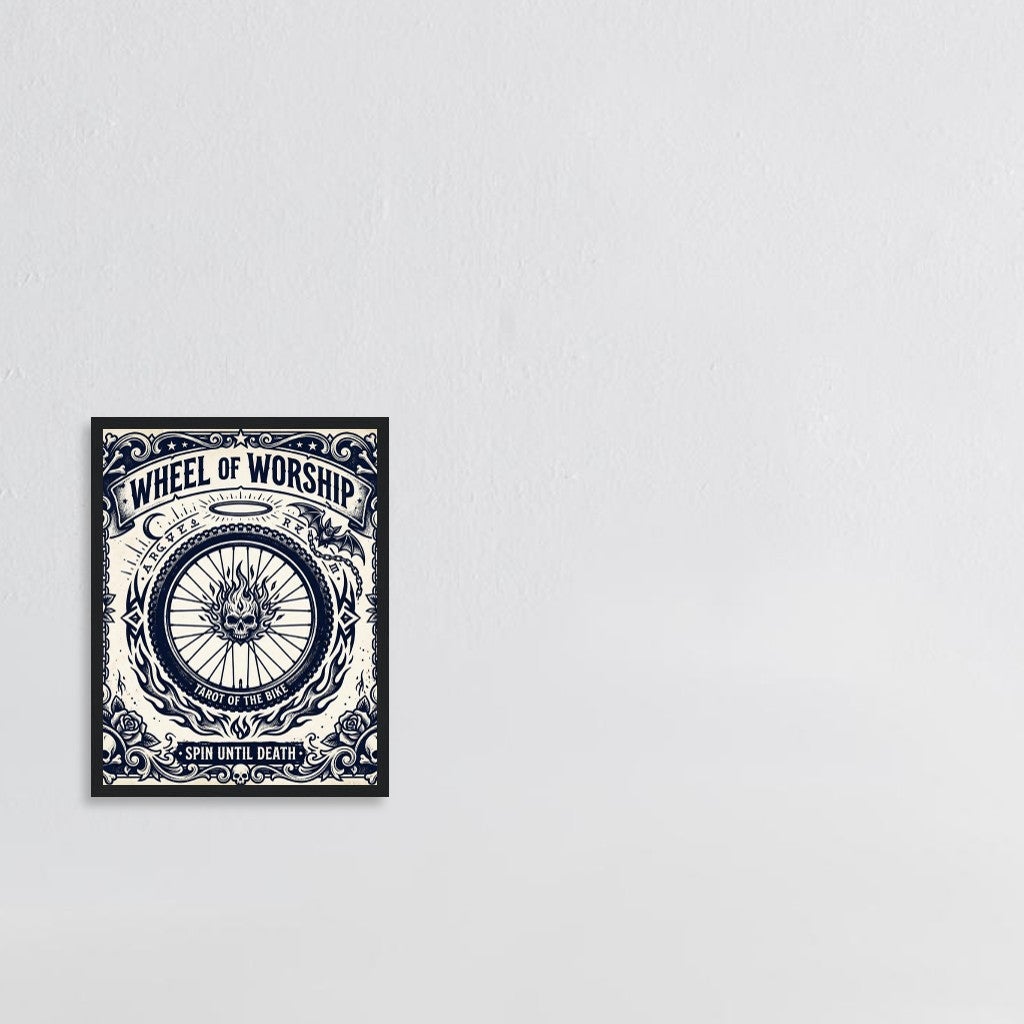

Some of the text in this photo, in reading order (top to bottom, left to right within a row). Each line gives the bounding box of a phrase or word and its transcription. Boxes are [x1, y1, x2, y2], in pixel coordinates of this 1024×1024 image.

[130, 452, 356, 511] WHEEL OF WORSHIP
[193, 683, 289, 706] TAROT OF THE BIKE
[185, 746, 296, 760] SPIN UNTIL DEATH
